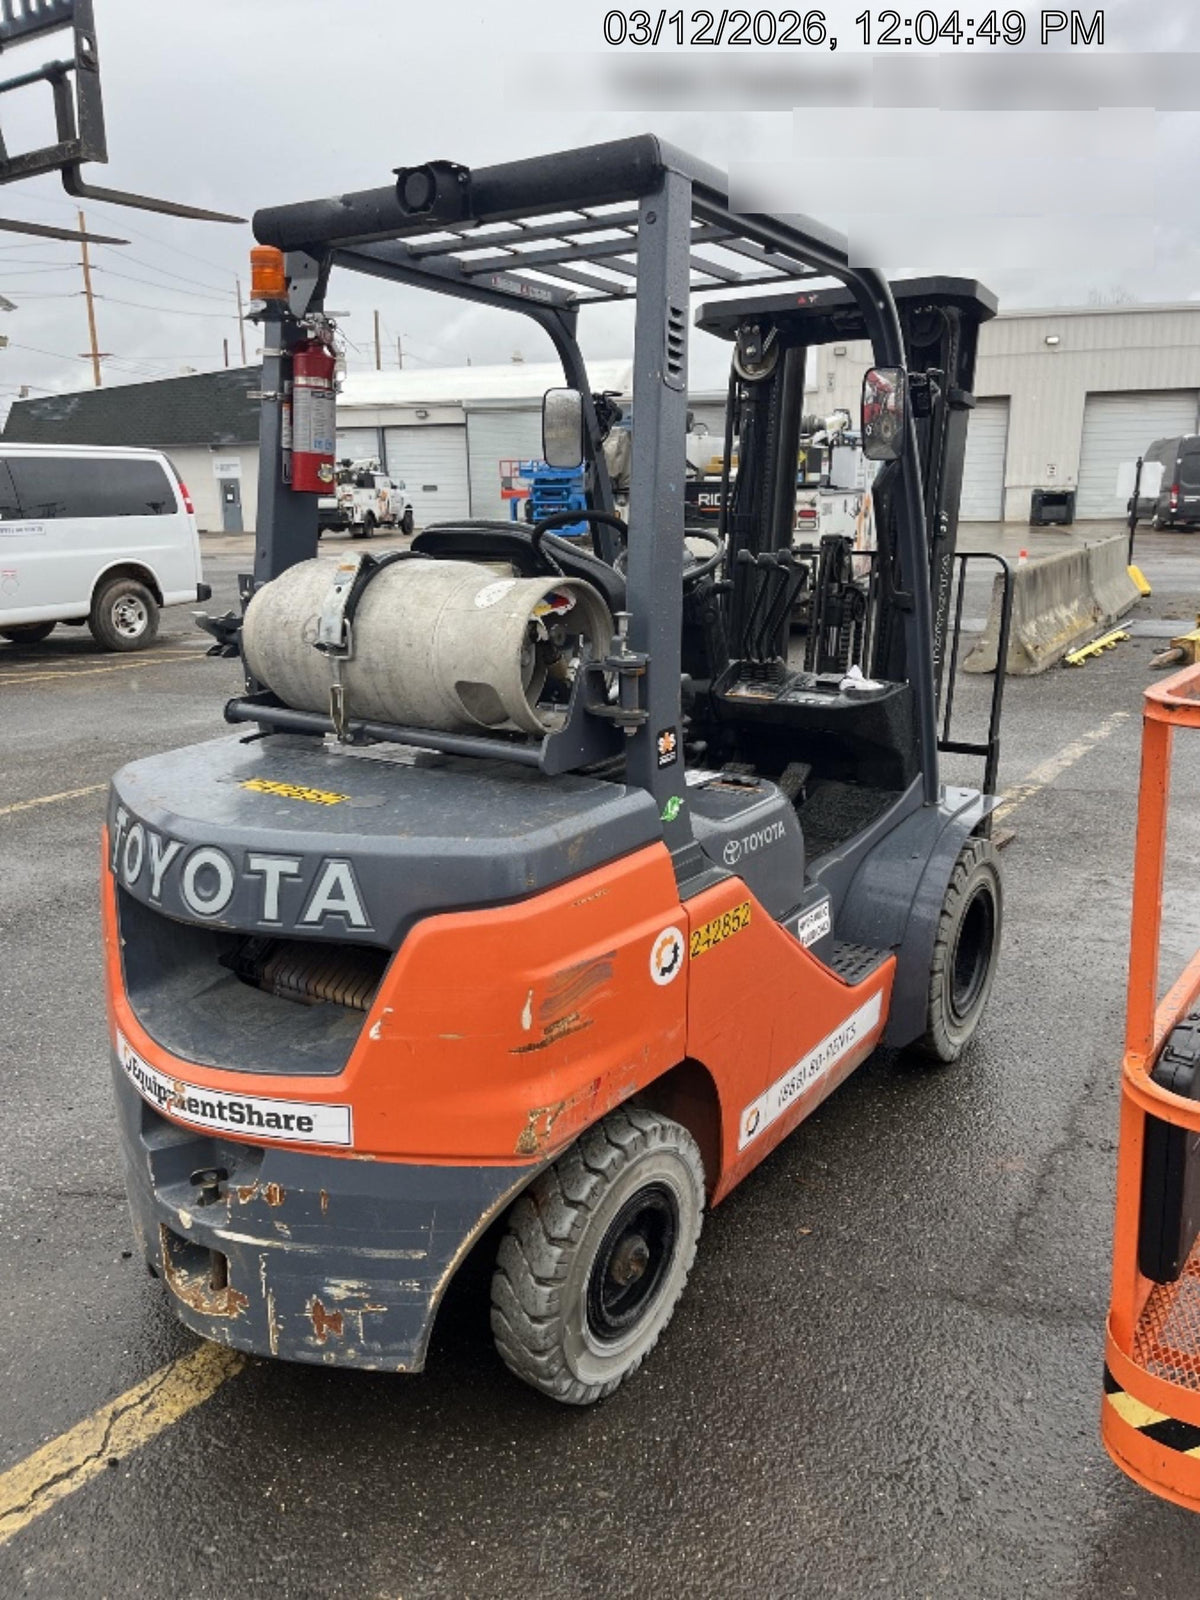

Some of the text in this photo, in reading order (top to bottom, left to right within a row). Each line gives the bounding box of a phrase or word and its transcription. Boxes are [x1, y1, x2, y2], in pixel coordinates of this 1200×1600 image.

[743, 820, 786, 854] TOYOTA
[113, 805, 373, 929] TOYOTA
[691, 902, 750, 958] 242852
